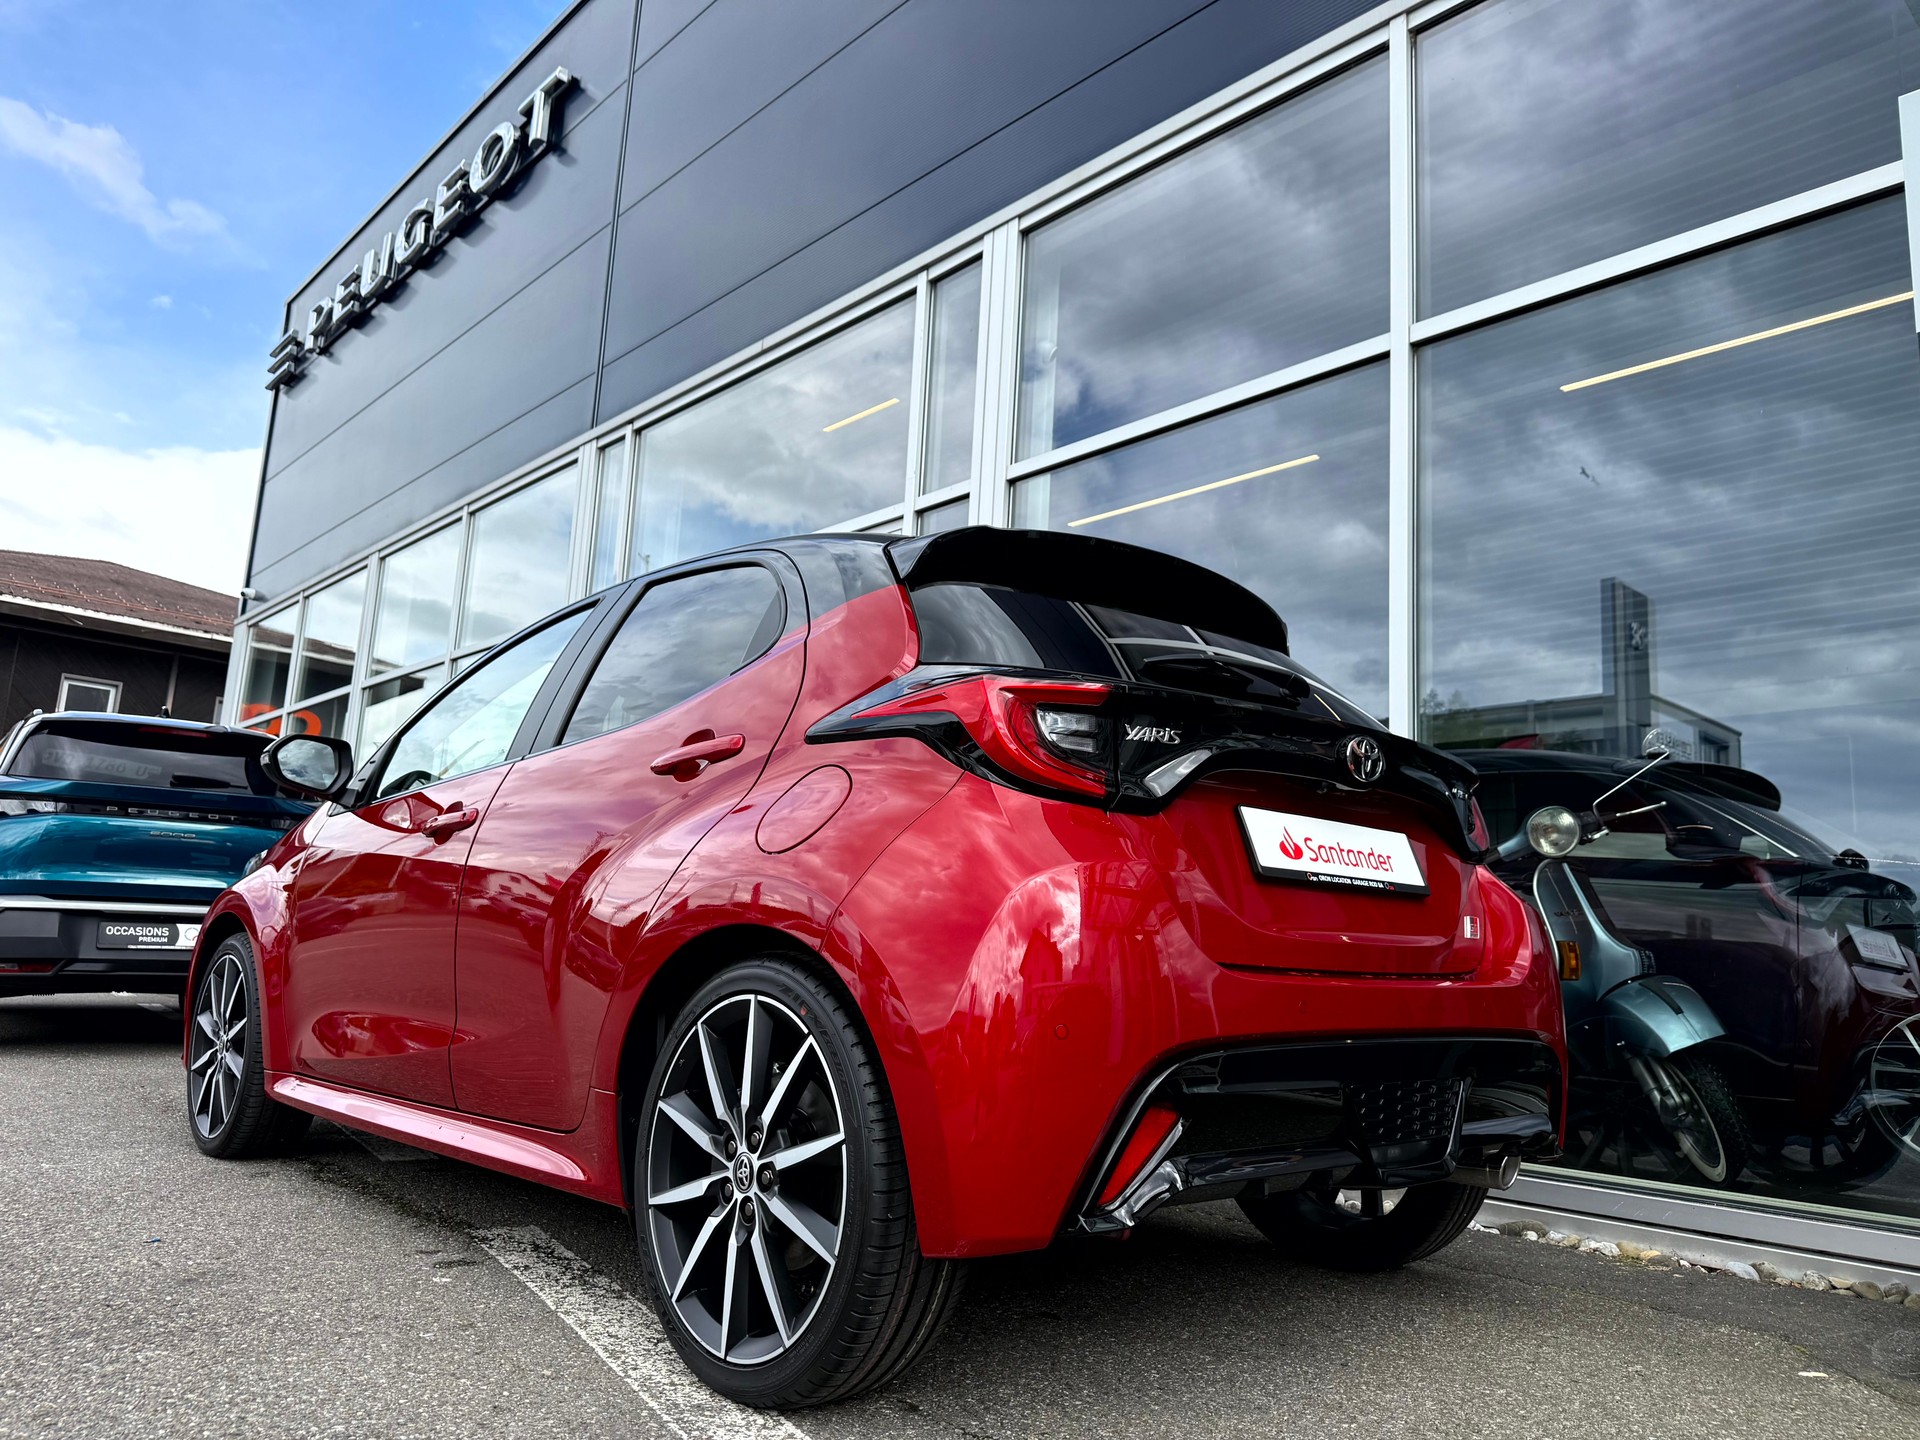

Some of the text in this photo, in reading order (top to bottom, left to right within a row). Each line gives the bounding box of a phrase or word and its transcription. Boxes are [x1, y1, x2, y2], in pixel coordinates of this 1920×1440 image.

[304, 65, 571, 354] PEUGEOT
[1124, 723, 1182, 745] YARIS
[106, 805, 238, 821] PEUGEOT
[1303, 836, 1394, 873] Santander
[1331, 876, 1352, 884] LOCATION
[1352, 878, 1369, 887] GARAGE
[105, 926, 169, 936] OCCASIONS
